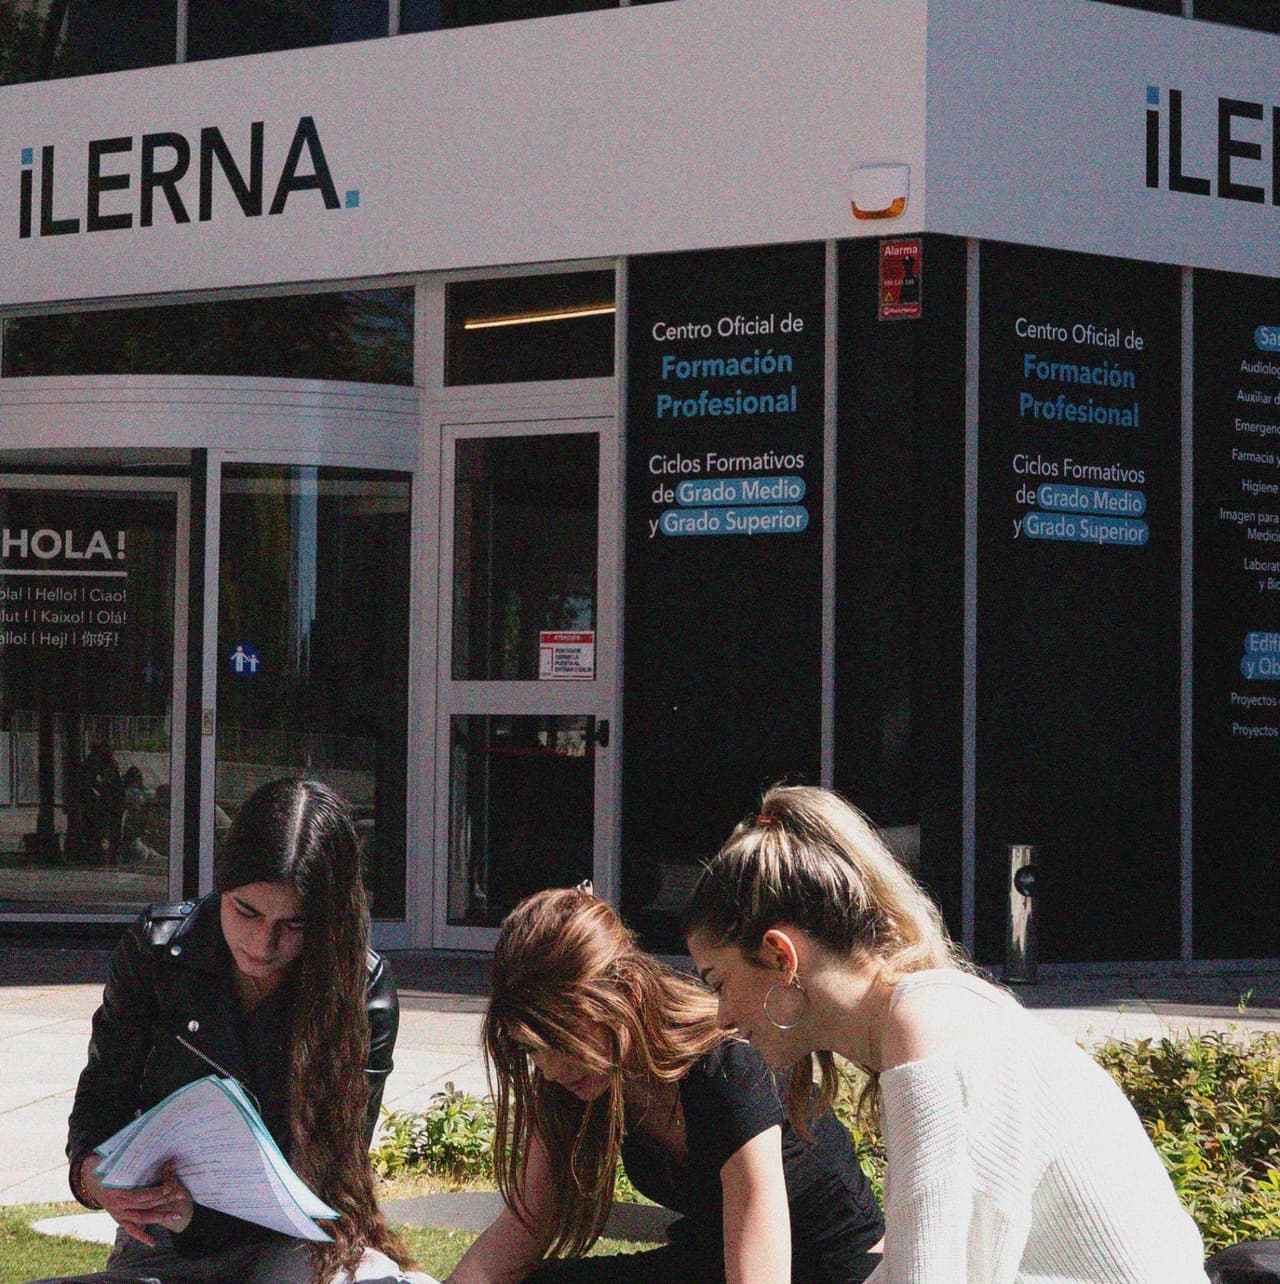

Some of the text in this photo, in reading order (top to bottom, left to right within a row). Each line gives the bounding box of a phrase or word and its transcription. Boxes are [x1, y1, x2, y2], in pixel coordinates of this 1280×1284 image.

[19, 116, 359, 239] iLERNA.
[884, 244, 918, 256] Alarma
[652, 312, 804, 341] Centro Oficial de
[1015, 318, 1143, 350] Centro Oficial de
[662, 349, 792, 380] Formación
[1024, 354, 1136, 389] Formación
[657, 386, 797, 418] Profesional
[1237, 390, 1271, 405] Auxiliar
[1020, 393, 1140, 428] Profesional
[649, 451, 804, 476] Ciclos Formativos
[1013, 455, 1145, 484] Ciclos Formativos
[1232, 449, 1273, 464] Farmacia
[1276, 456, 1280, 467] y
[652, 479, 801, 504] de Grado Medio
[1016, 485, 1142, 511] de Grado Medio
[1242, 480, 1278, 495] Higiene
[649, 510, 804, 538] y Grado Superior
[1220, 508, 1255, 524] Imagen
[1258, 513, 1279, 525] para
[1013, 516, 1144, 545] y Grado Superior
[36, 588, 76, 601] Hello!
[90, 589, 126, 602] Ciao!
[1259, 582, 1264, 592] y
[41, 610, 84, 624] Kaixo!
[97, 611, 126, 624] Olá!
[40, 632, 68, 649] Hej!
[1247, 663, 1254, 679] y
[1231, 693, 1276, 709] Proyectos
[1233, 724, 1278, 738] Proyectos
